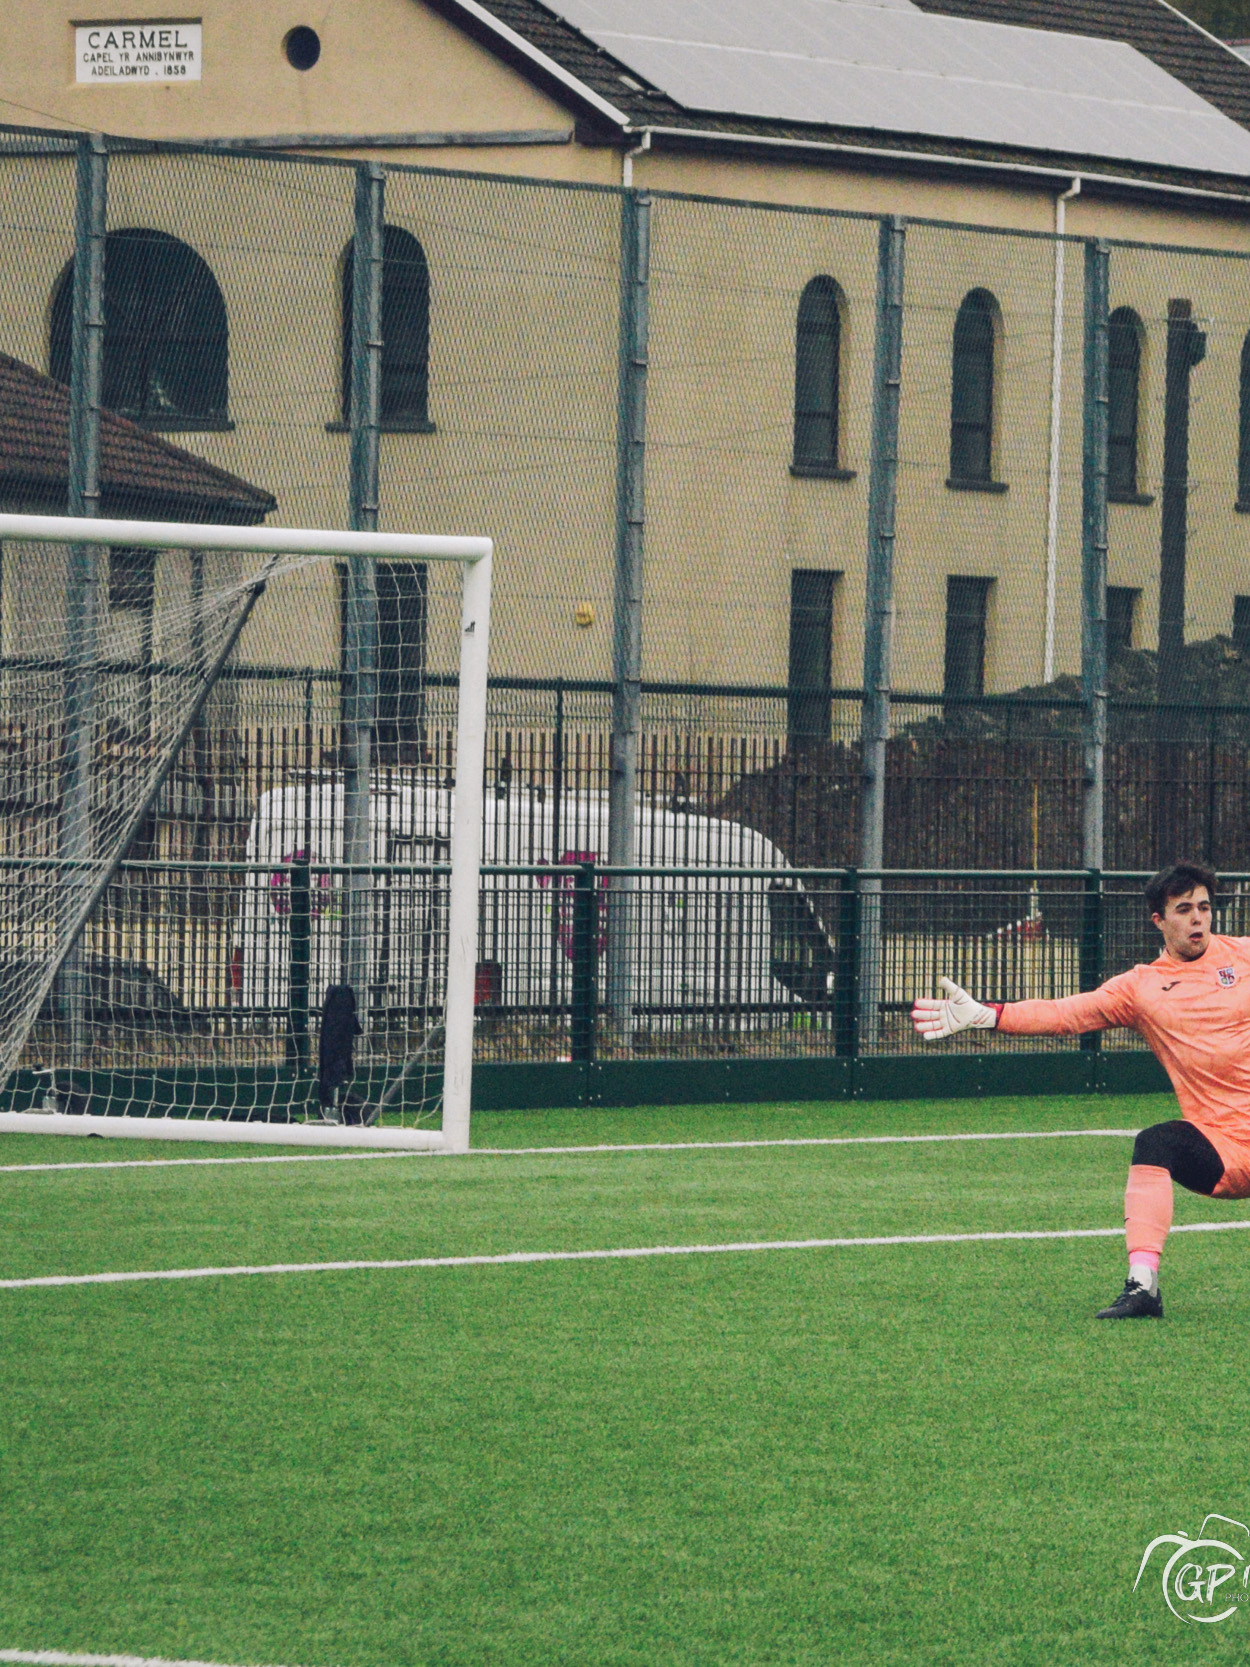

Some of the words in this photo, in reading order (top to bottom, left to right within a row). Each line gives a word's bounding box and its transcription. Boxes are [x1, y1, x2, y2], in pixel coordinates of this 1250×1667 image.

[88, 30, 188, 49] CARMEL
[83, 53, 114, 63] CAPEL
[119, 53, 130, 62] YR
[136, 51, 194, 62] ANNIBYNWYR
[91, 65, 150, 76] ADEILADWYD
[164, 65, 186, 75] 1858
